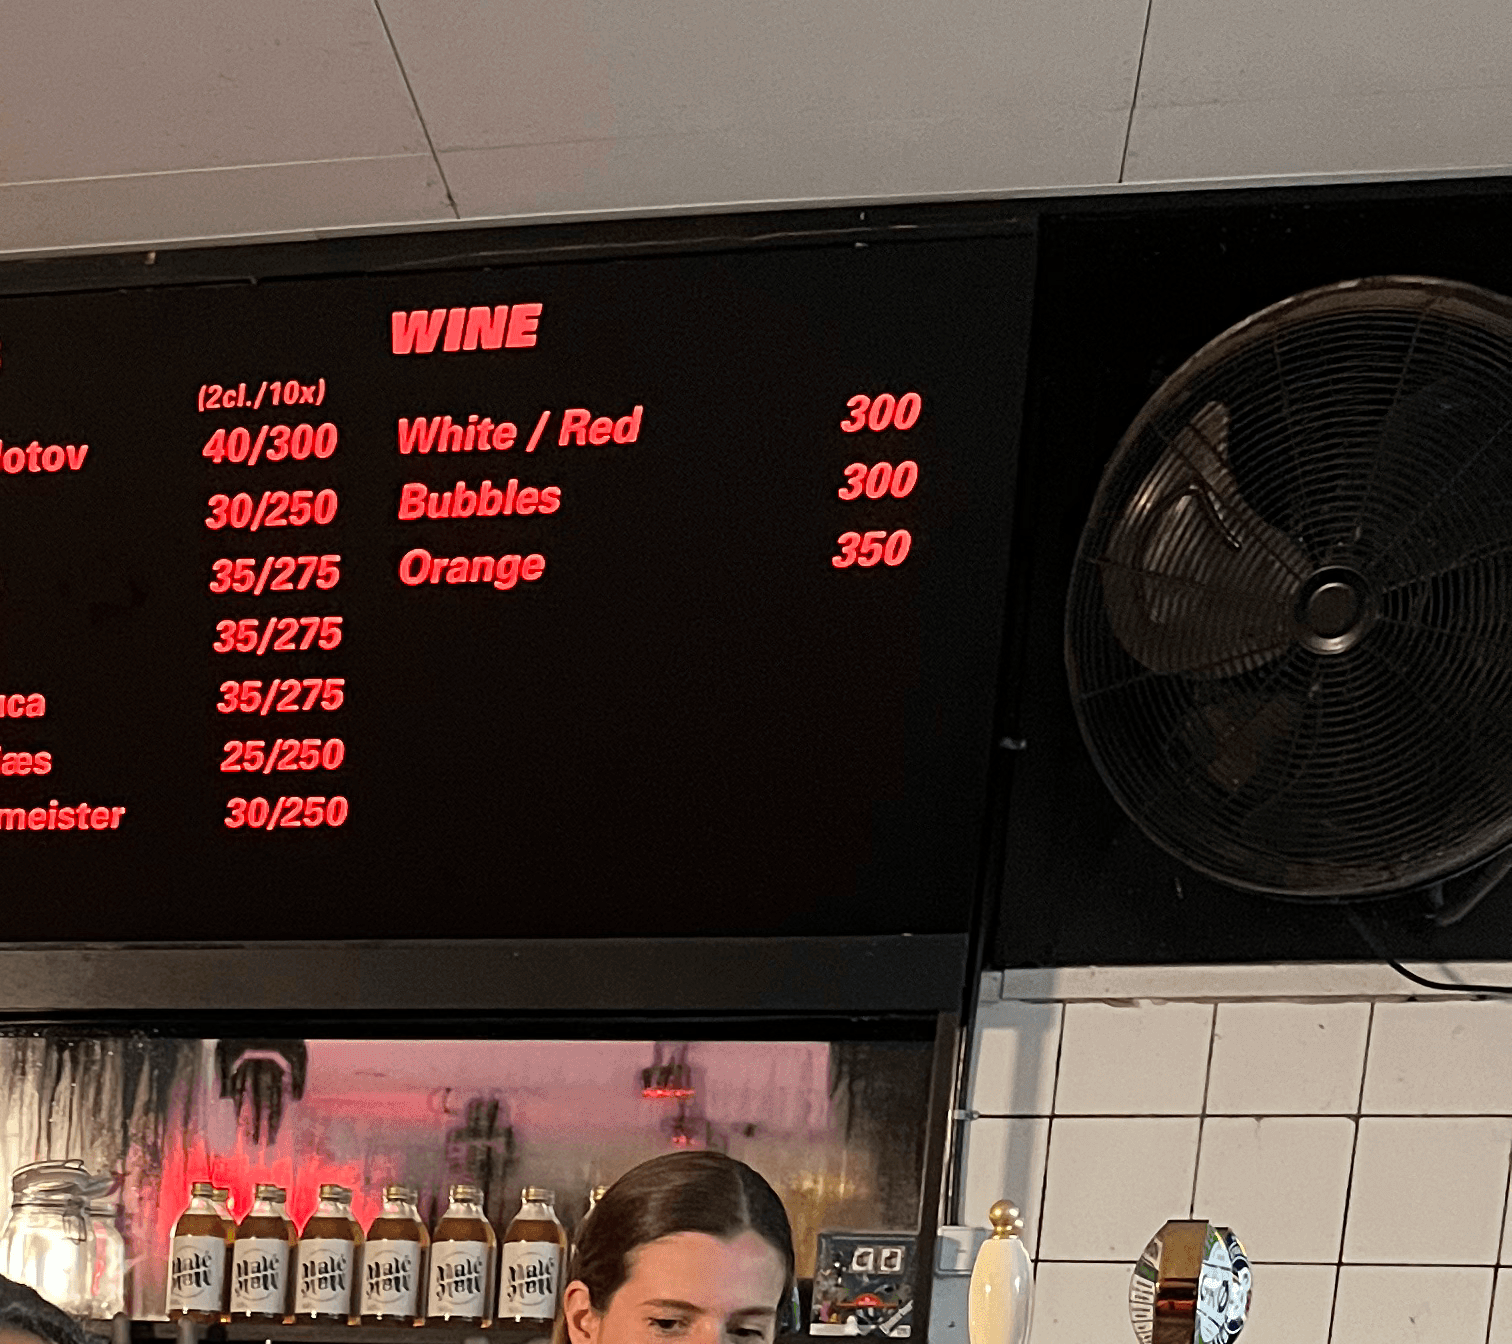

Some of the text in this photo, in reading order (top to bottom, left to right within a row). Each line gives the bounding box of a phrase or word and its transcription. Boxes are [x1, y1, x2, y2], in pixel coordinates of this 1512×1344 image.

[392, 303, 542, 354] WINE
[198, 378, 325, 412] (2cl./10x)
[840, 392, 921, 432] 300
[202, 423, 337, 466] 40/300
[398, 406, 643, 454] White / Red
[398, 479, 561, 520] Bubbles
[838, 461, 918, 500] 300
[205, 489, 337, 531] 30/250
[832, 530, 911, 568] 350
[210, 555, 340, 596] 35/275
[399, 549, 545, 590] Orange
[213, 617, 342, 655] 35/275
[217, 678, 344, 716] 35/275
[220, 738, 344, 774] 25/250
[224, 796, 348, 830] 30/250
